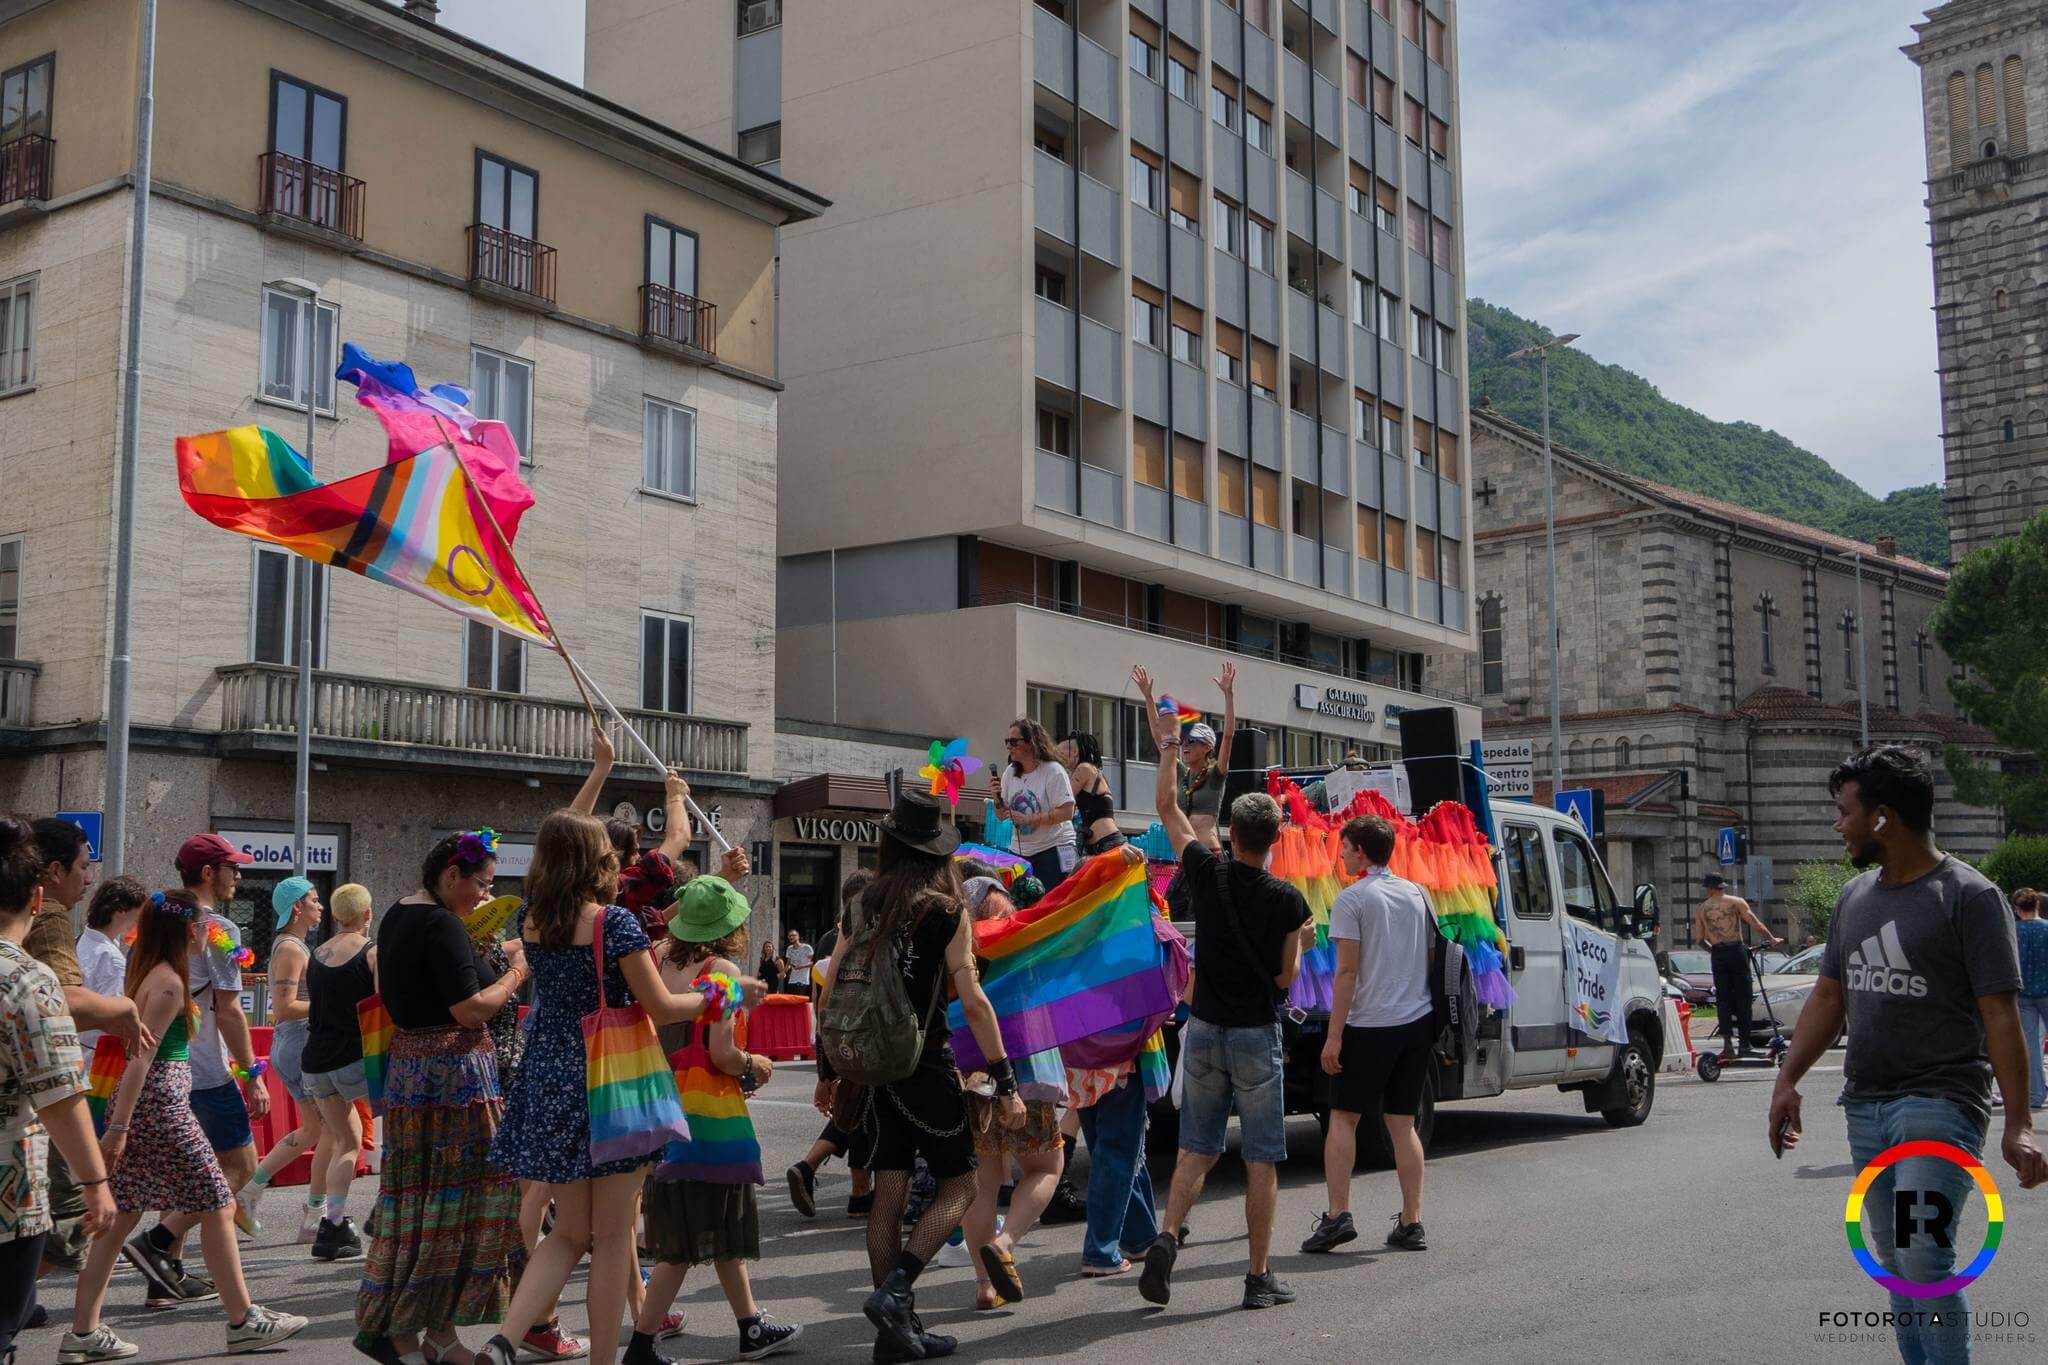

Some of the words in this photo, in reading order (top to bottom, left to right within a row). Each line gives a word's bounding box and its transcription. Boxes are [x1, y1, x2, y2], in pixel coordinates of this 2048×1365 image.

[1481, 746, 1529, 760] spedale
[1490, 768, 1529, 779] centro
[242, 845, 332, 864] SoloAitti
[1575, 927, 1607, 964] Lecco
[1577, 967, 1605, 1001] Pride
